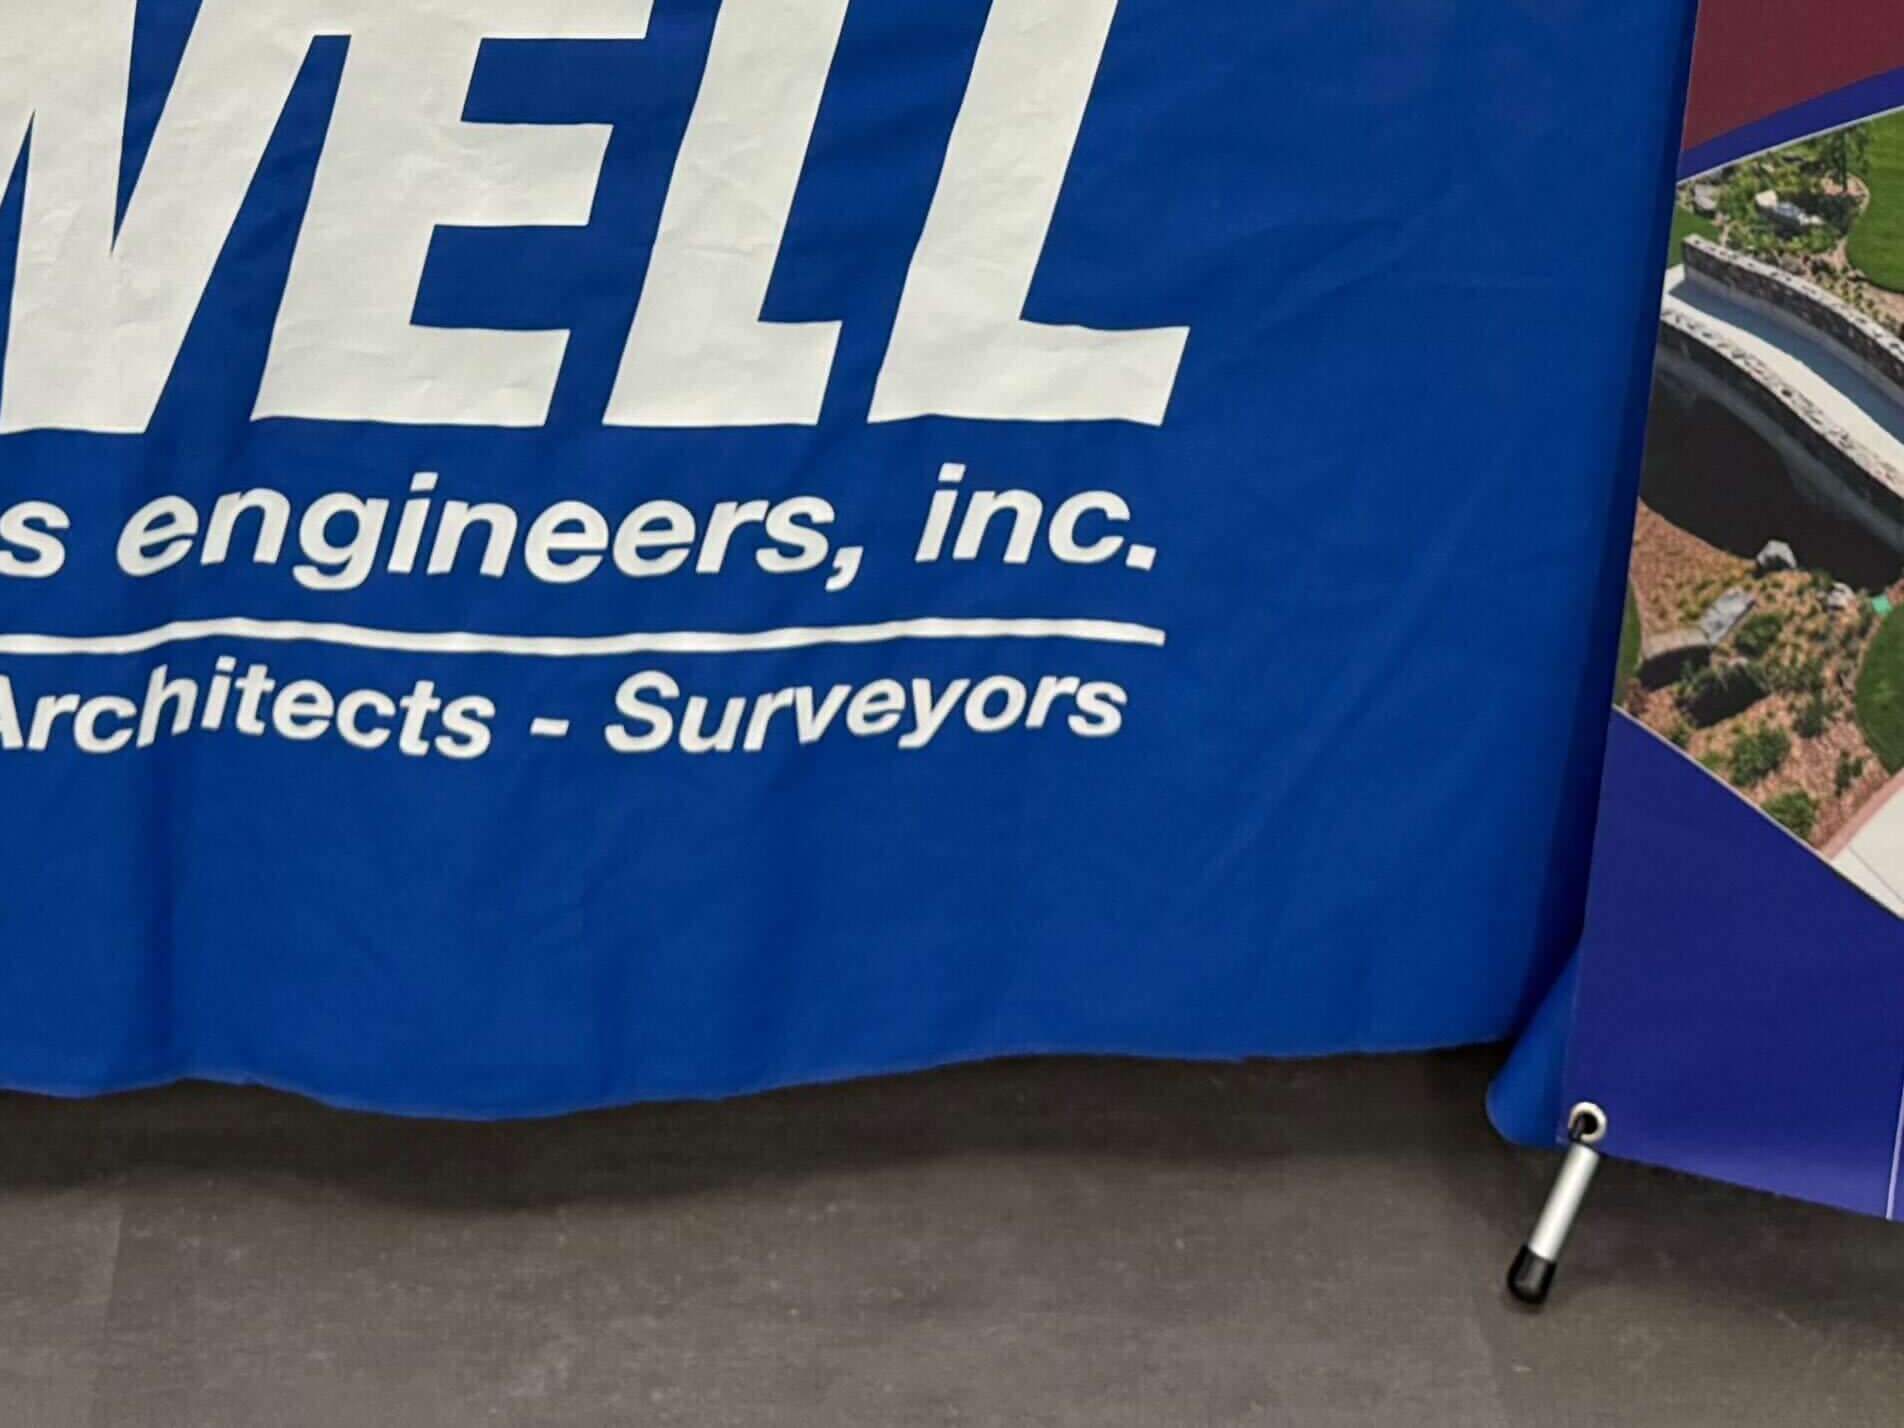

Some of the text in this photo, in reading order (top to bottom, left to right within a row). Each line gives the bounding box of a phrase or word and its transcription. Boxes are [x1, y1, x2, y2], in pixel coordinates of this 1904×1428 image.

[116, 470, 864, 592] engineers,
[915, 462, 1158, 572] inc.
[603, 664, 1128, 756] Surveyors
